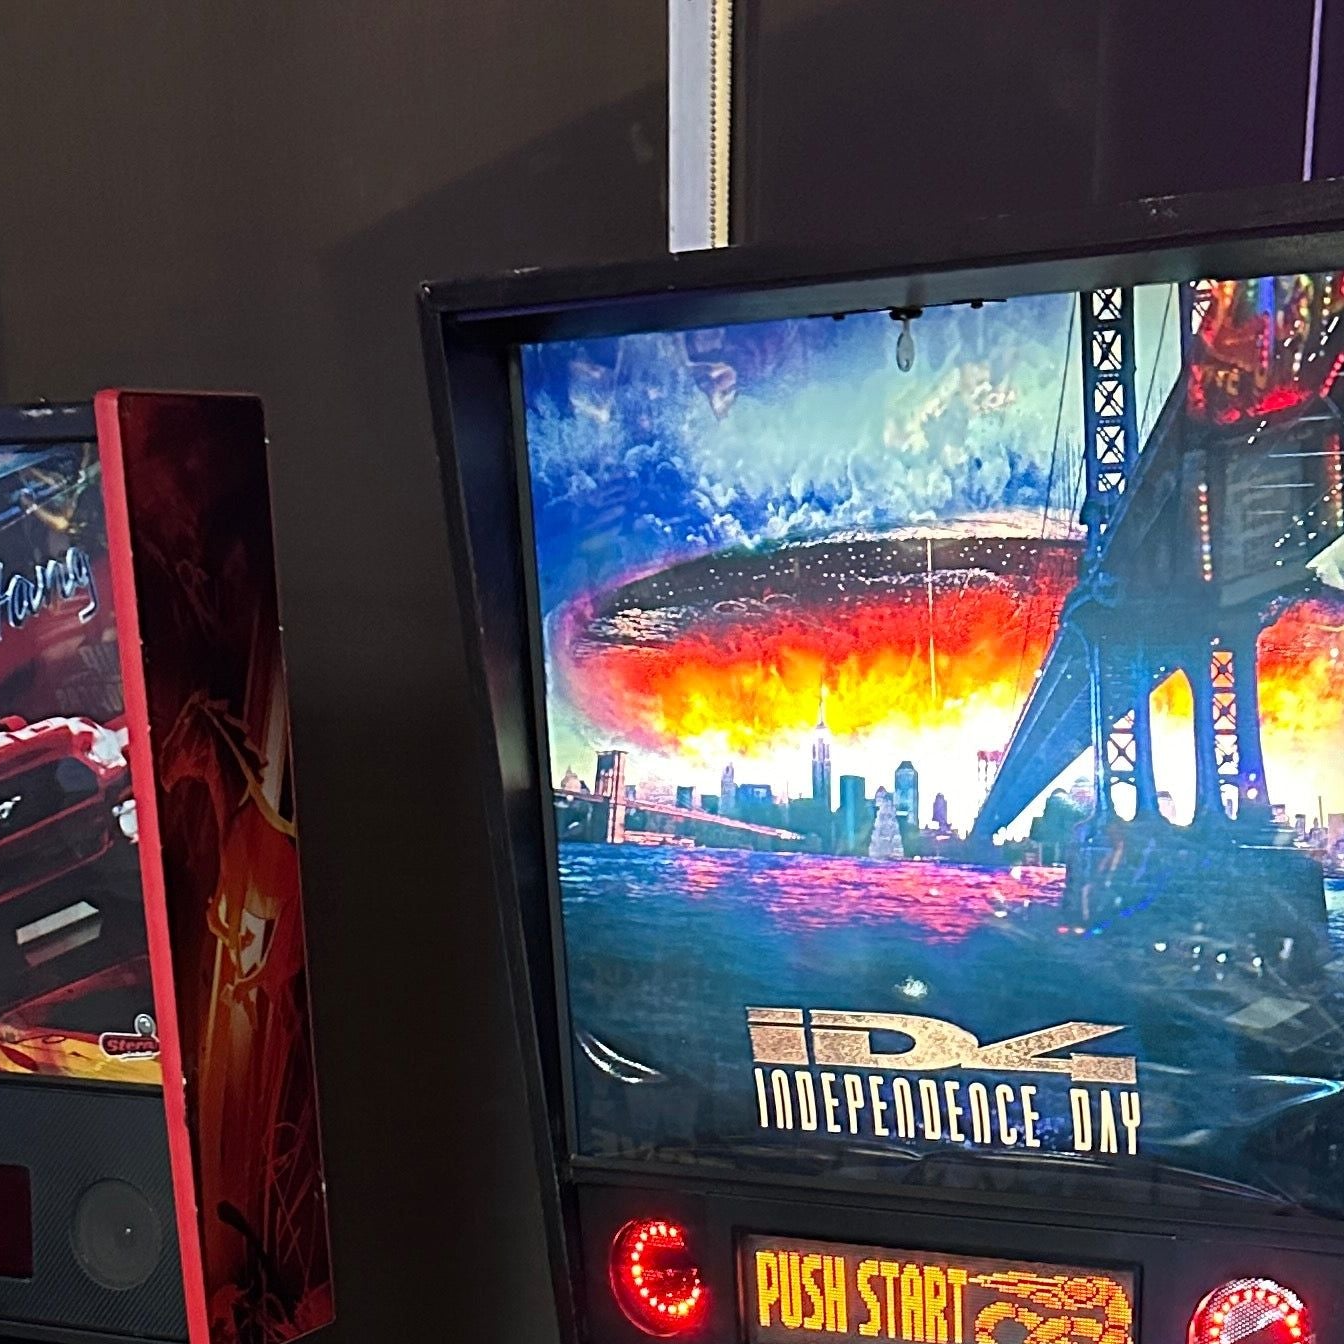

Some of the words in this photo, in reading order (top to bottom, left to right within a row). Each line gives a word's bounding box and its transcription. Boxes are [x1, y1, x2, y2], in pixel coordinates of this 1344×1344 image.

[106, 1039, 156, 1052] Stern
[754, 1068, 1042, 1149] INDEPENDENCE
[1071, 1088, 1143, 1156] DAY
[755, 1249, 849, 1334] PUSH
